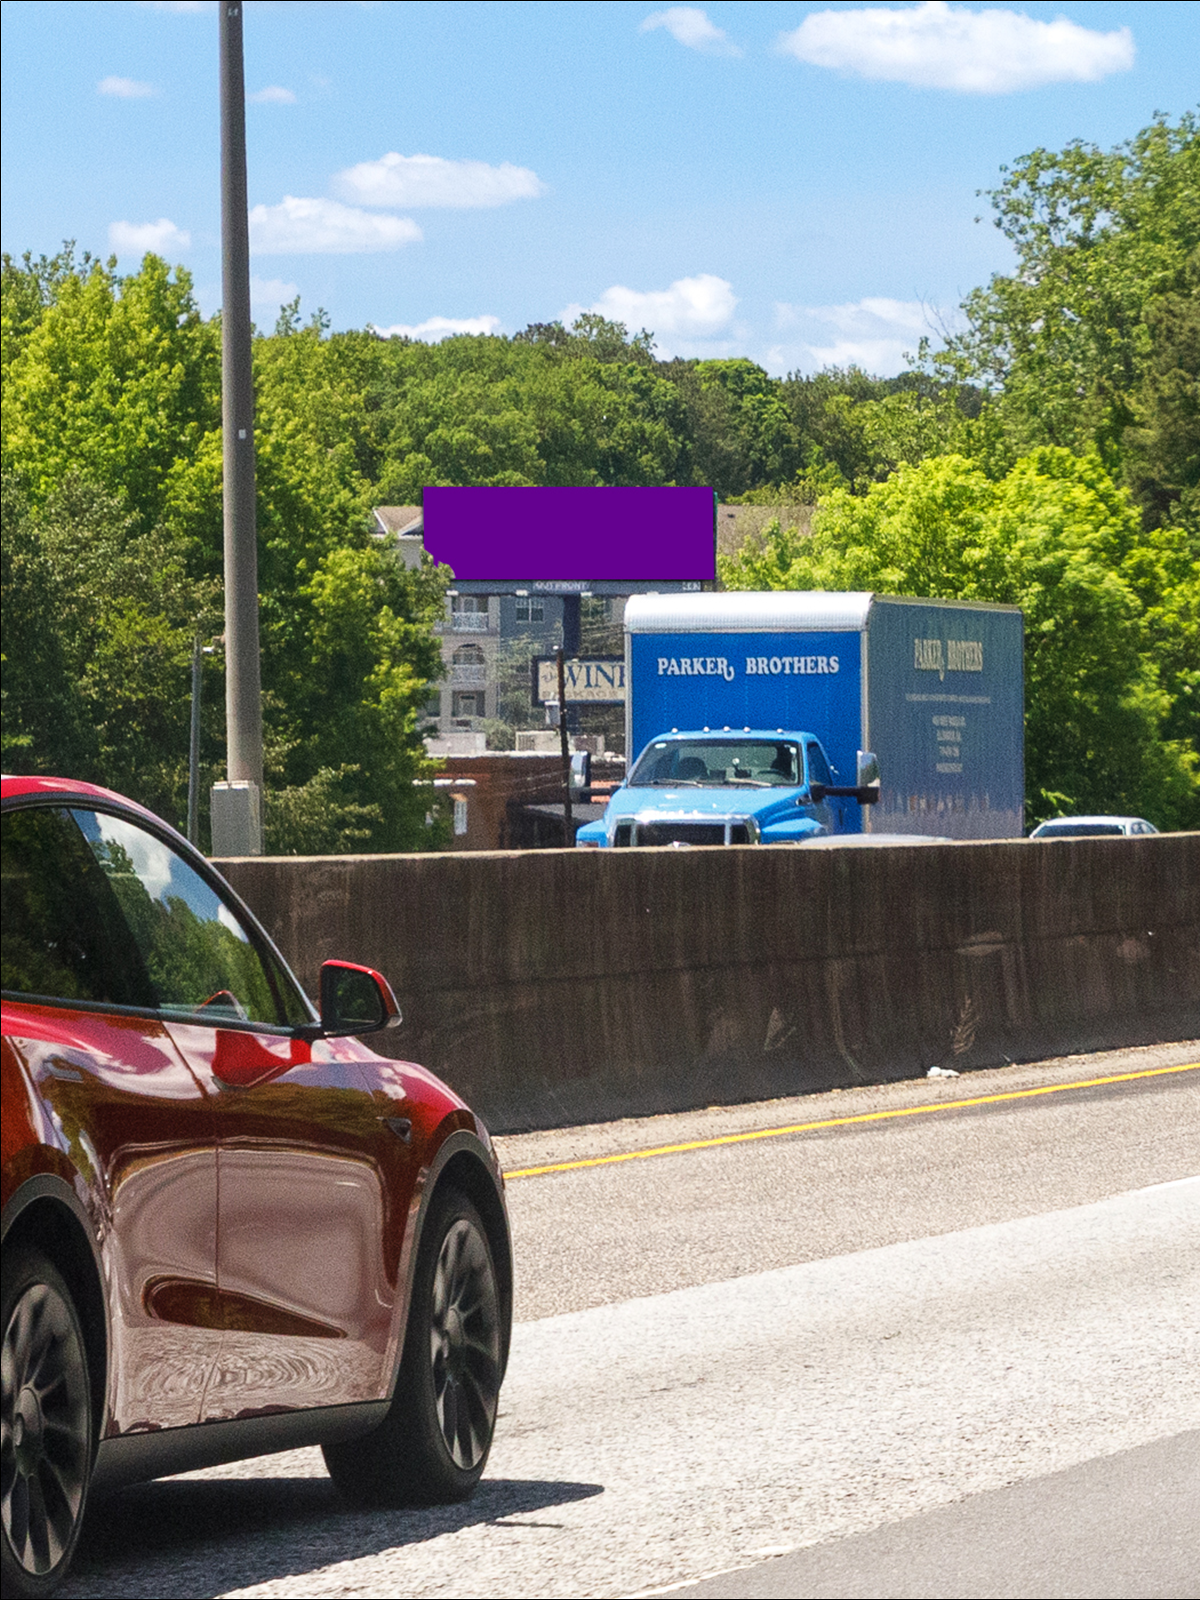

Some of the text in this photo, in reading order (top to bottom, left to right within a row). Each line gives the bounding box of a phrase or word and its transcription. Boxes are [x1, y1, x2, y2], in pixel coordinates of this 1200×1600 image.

[657, 656, 840, 681] PARKER BROTHERS
[914, 638, 983, 681] PARKER BROTHERS
[563, 665, 625, 688] WIN
